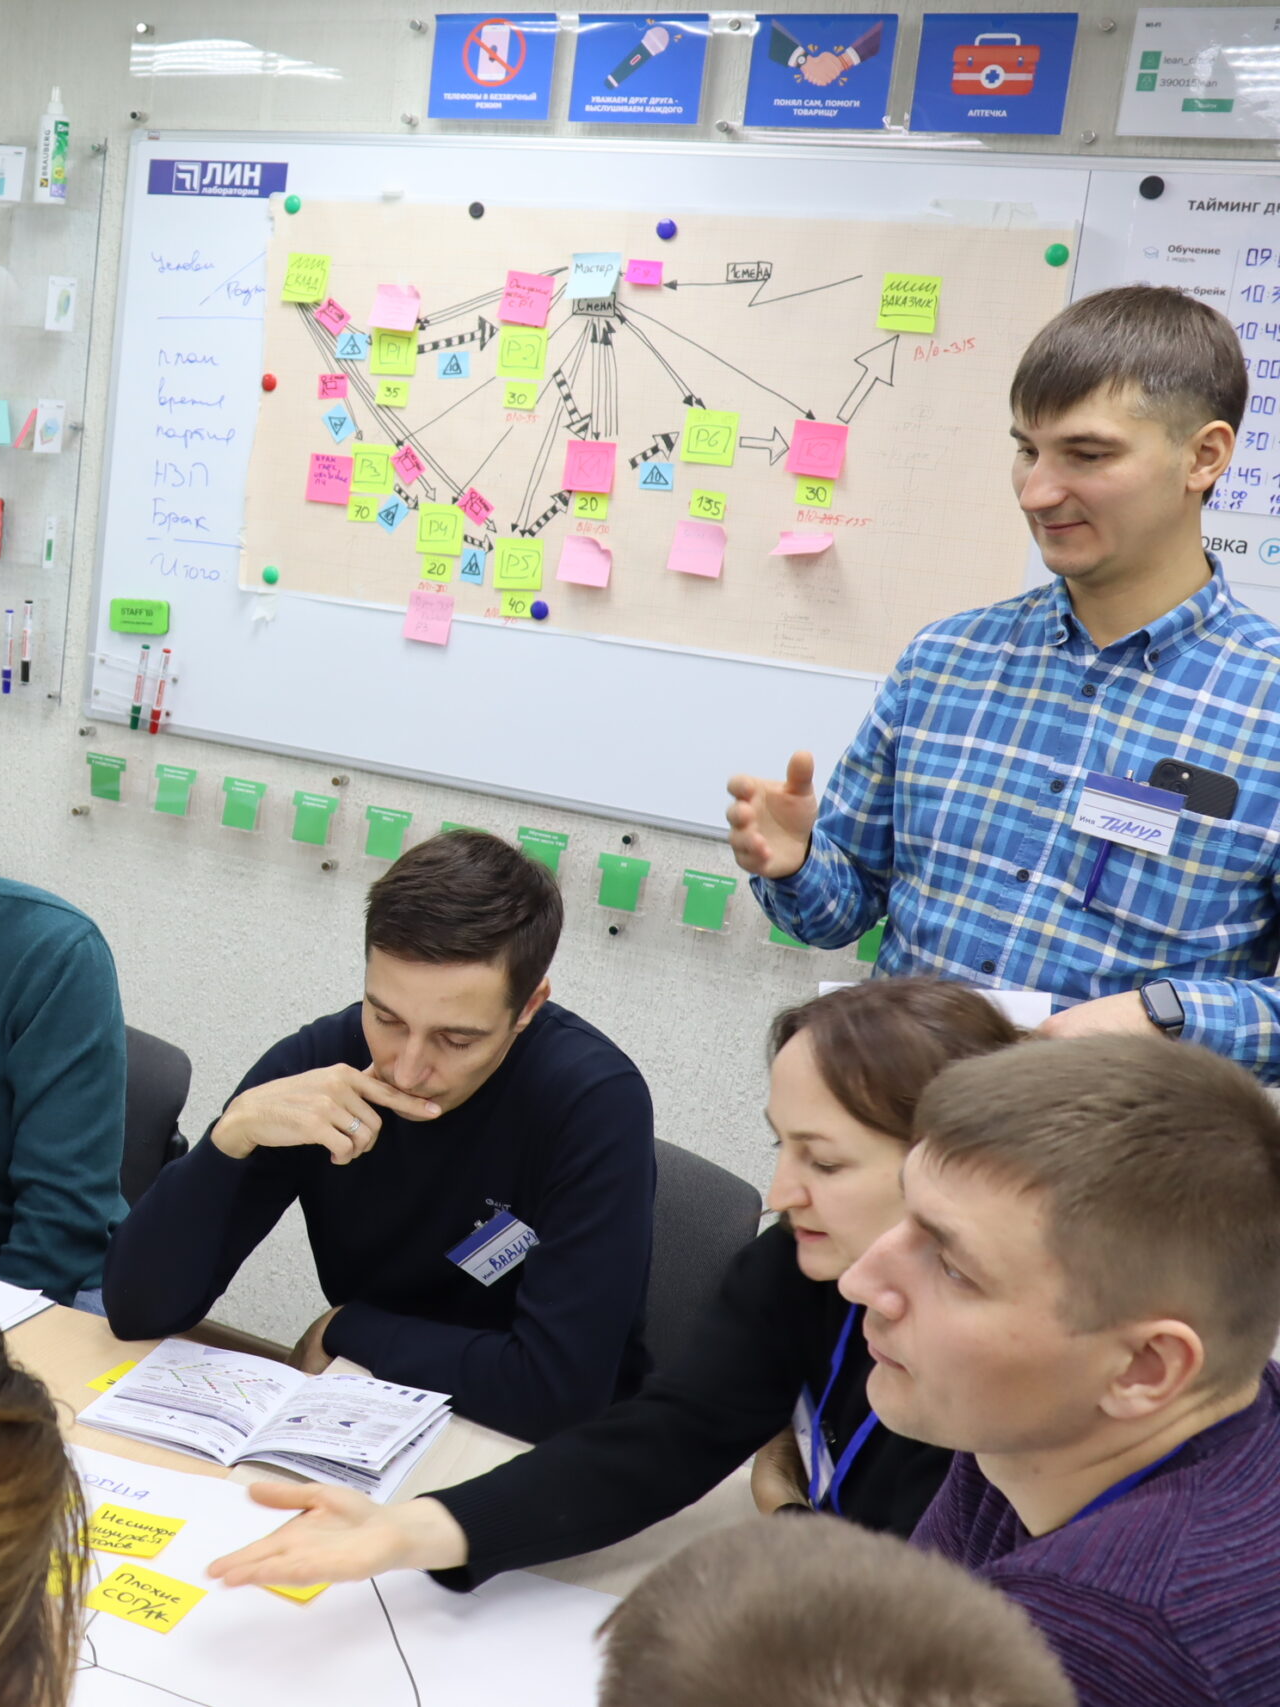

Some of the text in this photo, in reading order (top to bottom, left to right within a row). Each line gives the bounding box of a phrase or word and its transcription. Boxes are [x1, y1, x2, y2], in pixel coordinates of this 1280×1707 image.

[443, 93, 481, 101] ТЕЛЕФОНЫ
[591, 96, 627, 104] УВАЖАЕМ
[628, 96, 647, 105] ДРУГ
[649, 96, 673, 105] ДРУГА
[773, 99, 802, 107] ПОНЯЛ
[825, 99, 860, 108] ПОМОГИ
[475, 101, 502, 109] РЕЖИМ
[584, 104, 683, 114] ВЫСЛУШИВАЕМ КАЖДОГО
[793, 108, 838, 117] ТОВАРИЩУ
[968, 109, 1007, 117] АПТЕЧКА
[202, 162, 262, 186] ЛИН
[201, 185, 260, 196] лаборатория
[1188, 198, 1261, 213] ТАЙМИНГ
[1168, 244, 1221, 256] Обучение
[574, 263, 614, 278] Мастер
[384, 386, 401, 398] 35
[507, 391, 528, 405] 30
[805, 486, 828, 503] 30
[578, 496, 599, 511] 20
[696, 496, 722, 516] 135
[152, 497, 210, 532] Брак
[353, 506, 370, 519] 70
[427, 562, 447, 576] 20
[508, 598, 526, 614] 40
[1100, 814, 1163, 840] ТИМУР
[488, 1230, 537, 1272] ВАДИМ
[115, 1572, 182, 1604] Плохие
